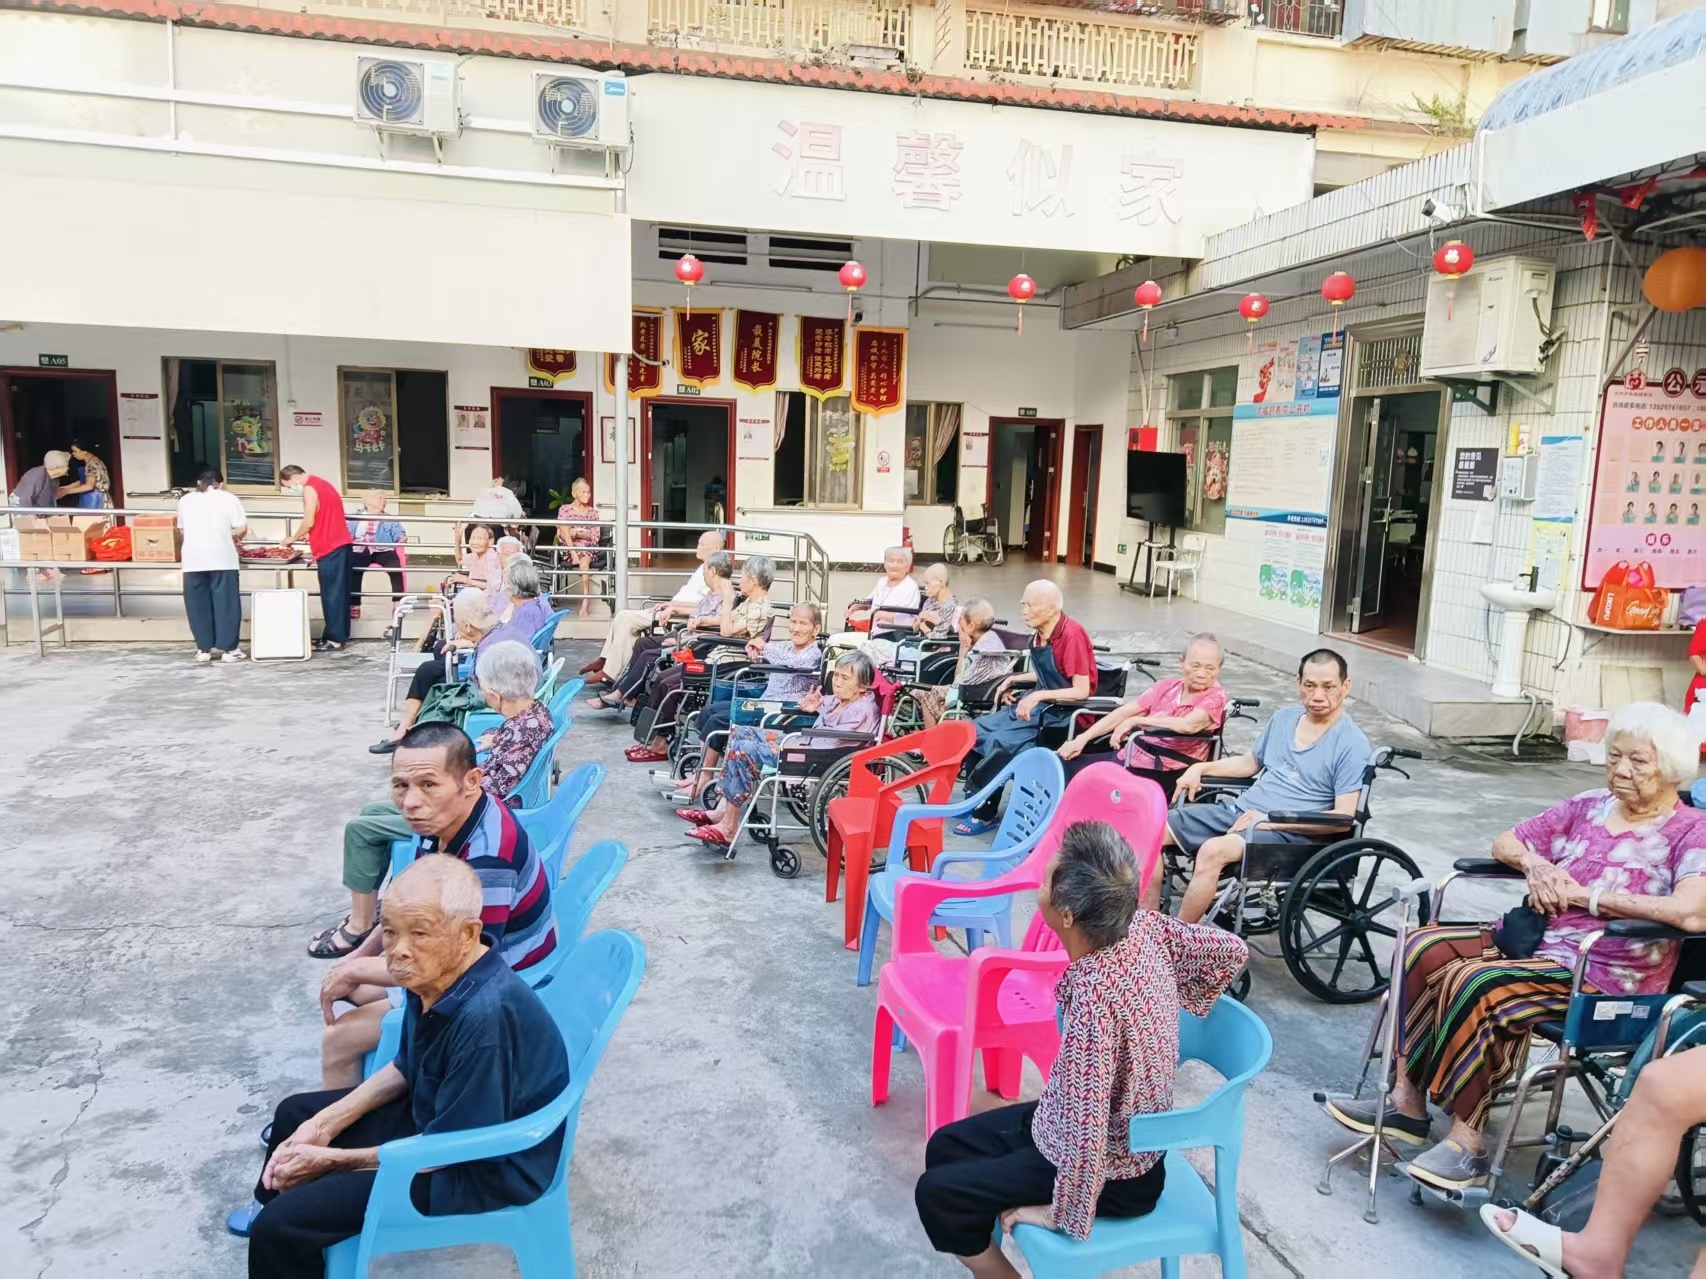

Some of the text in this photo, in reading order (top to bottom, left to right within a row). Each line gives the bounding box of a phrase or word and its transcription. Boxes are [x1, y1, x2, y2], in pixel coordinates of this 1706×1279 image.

[772, 119, 1184, 226] 温馨似家
[691, 329, 711, 355] 家
[751, 324, 763, 373] 最美院长
[686, 386, 700, 394] A02
